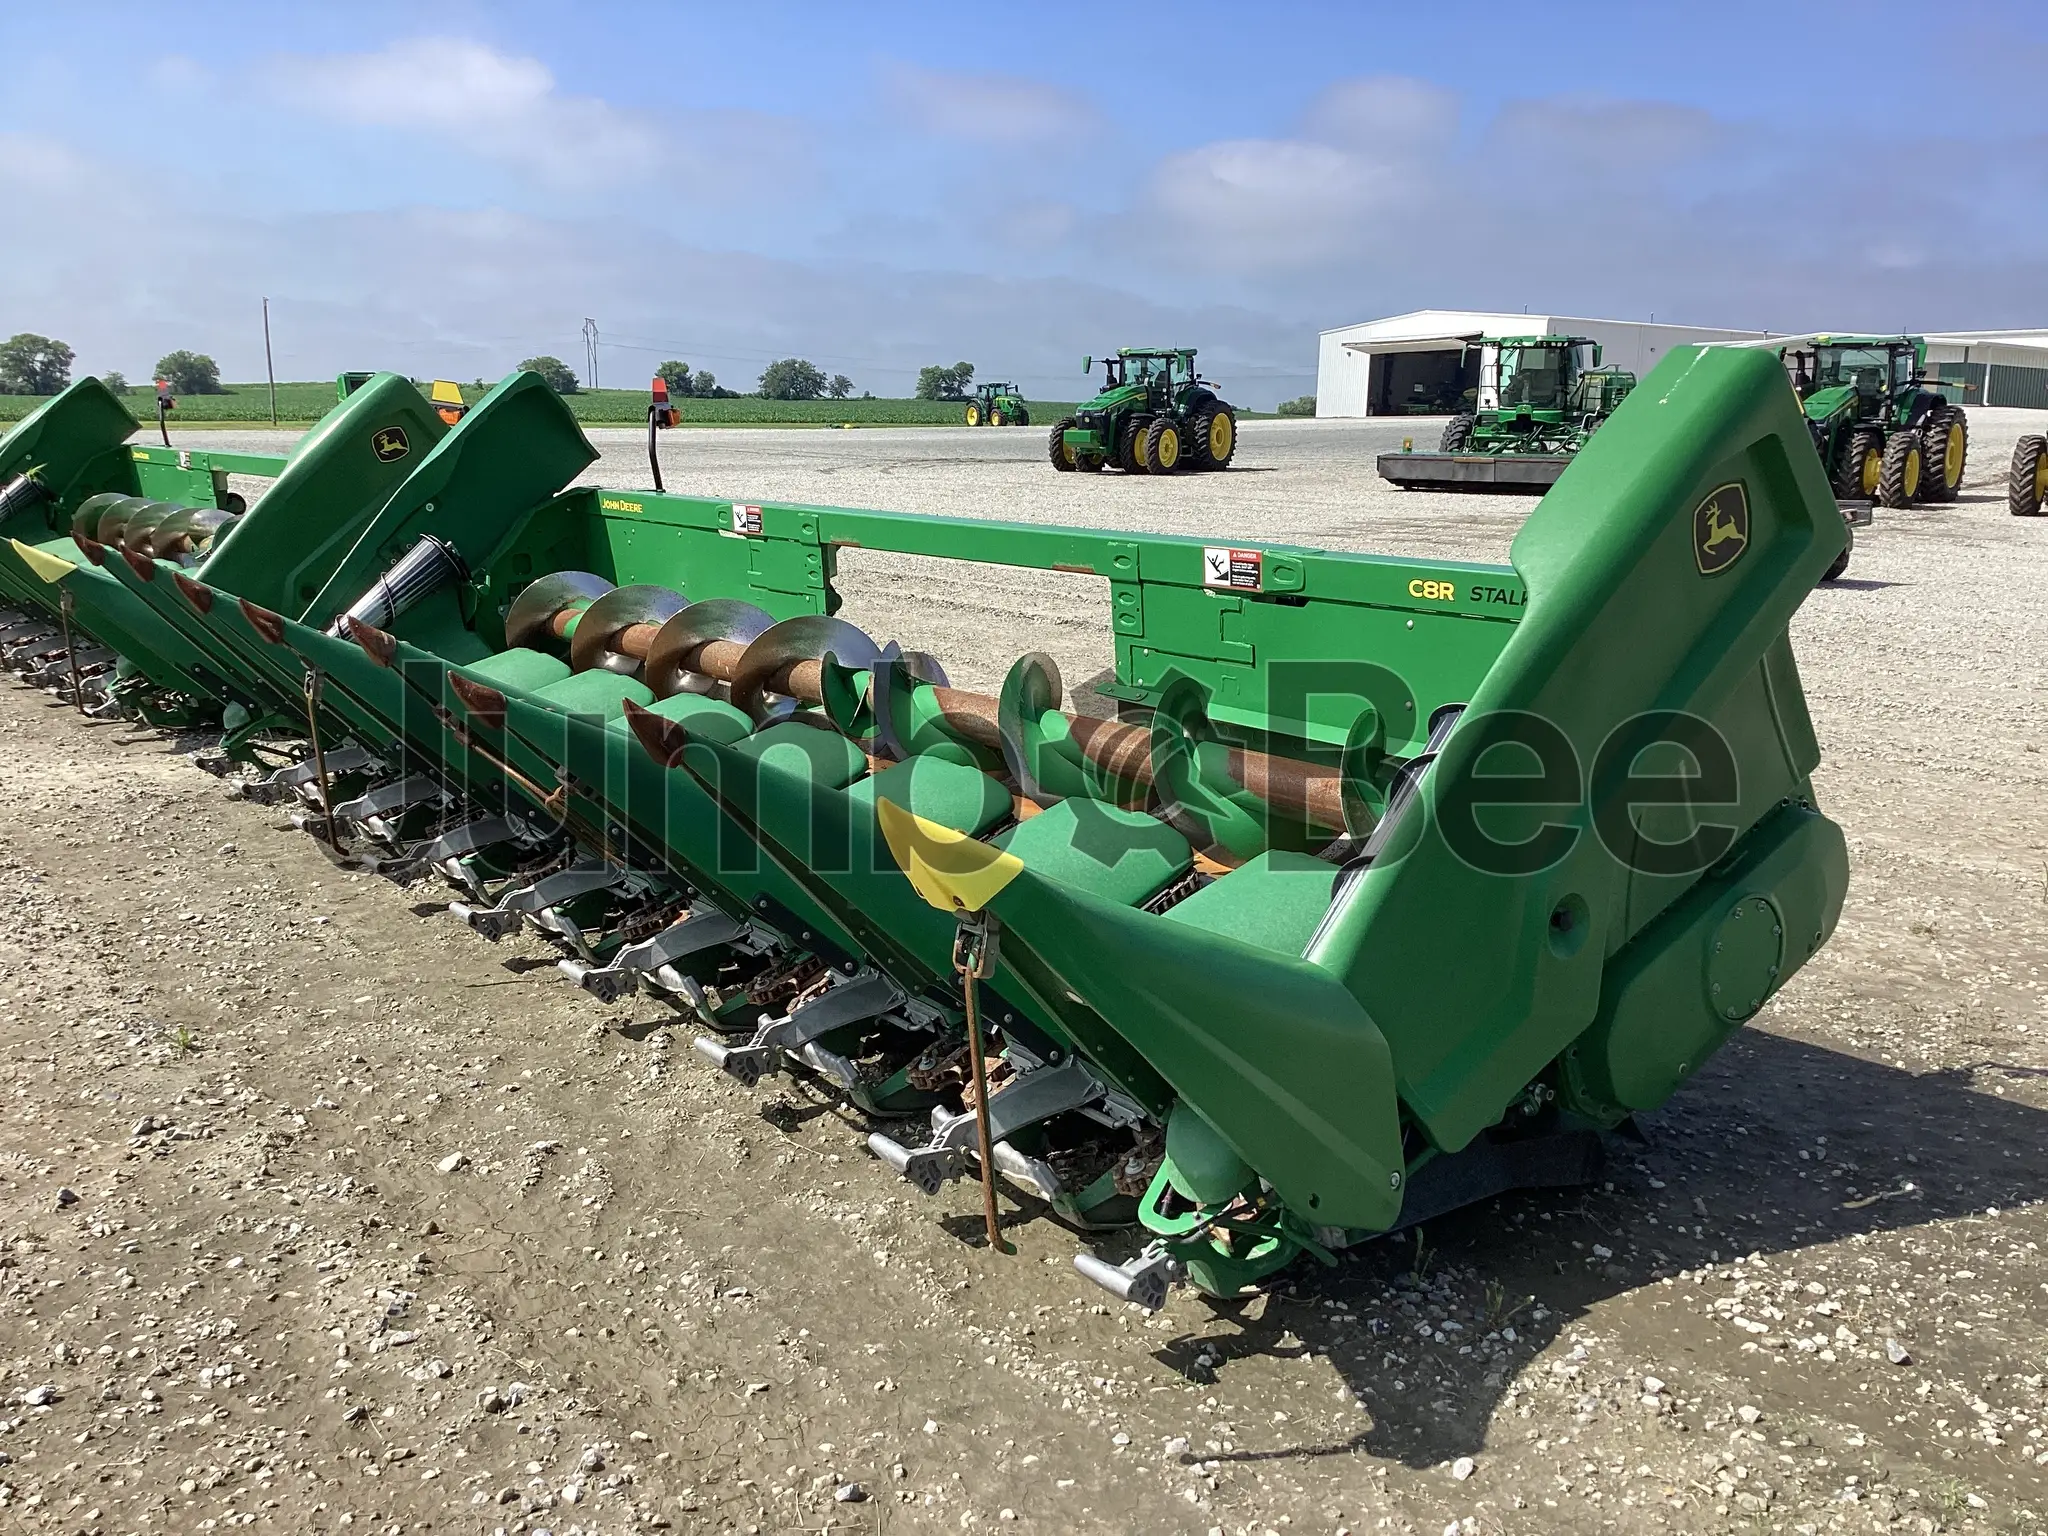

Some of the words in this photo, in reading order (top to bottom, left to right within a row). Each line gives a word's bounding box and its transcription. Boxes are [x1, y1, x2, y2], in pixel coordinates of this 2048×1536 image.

[602, 498, 620, 510] JOHN
[620, 499, 643, 513] DEERE
[1408, 579, 1455, 601] C8R
